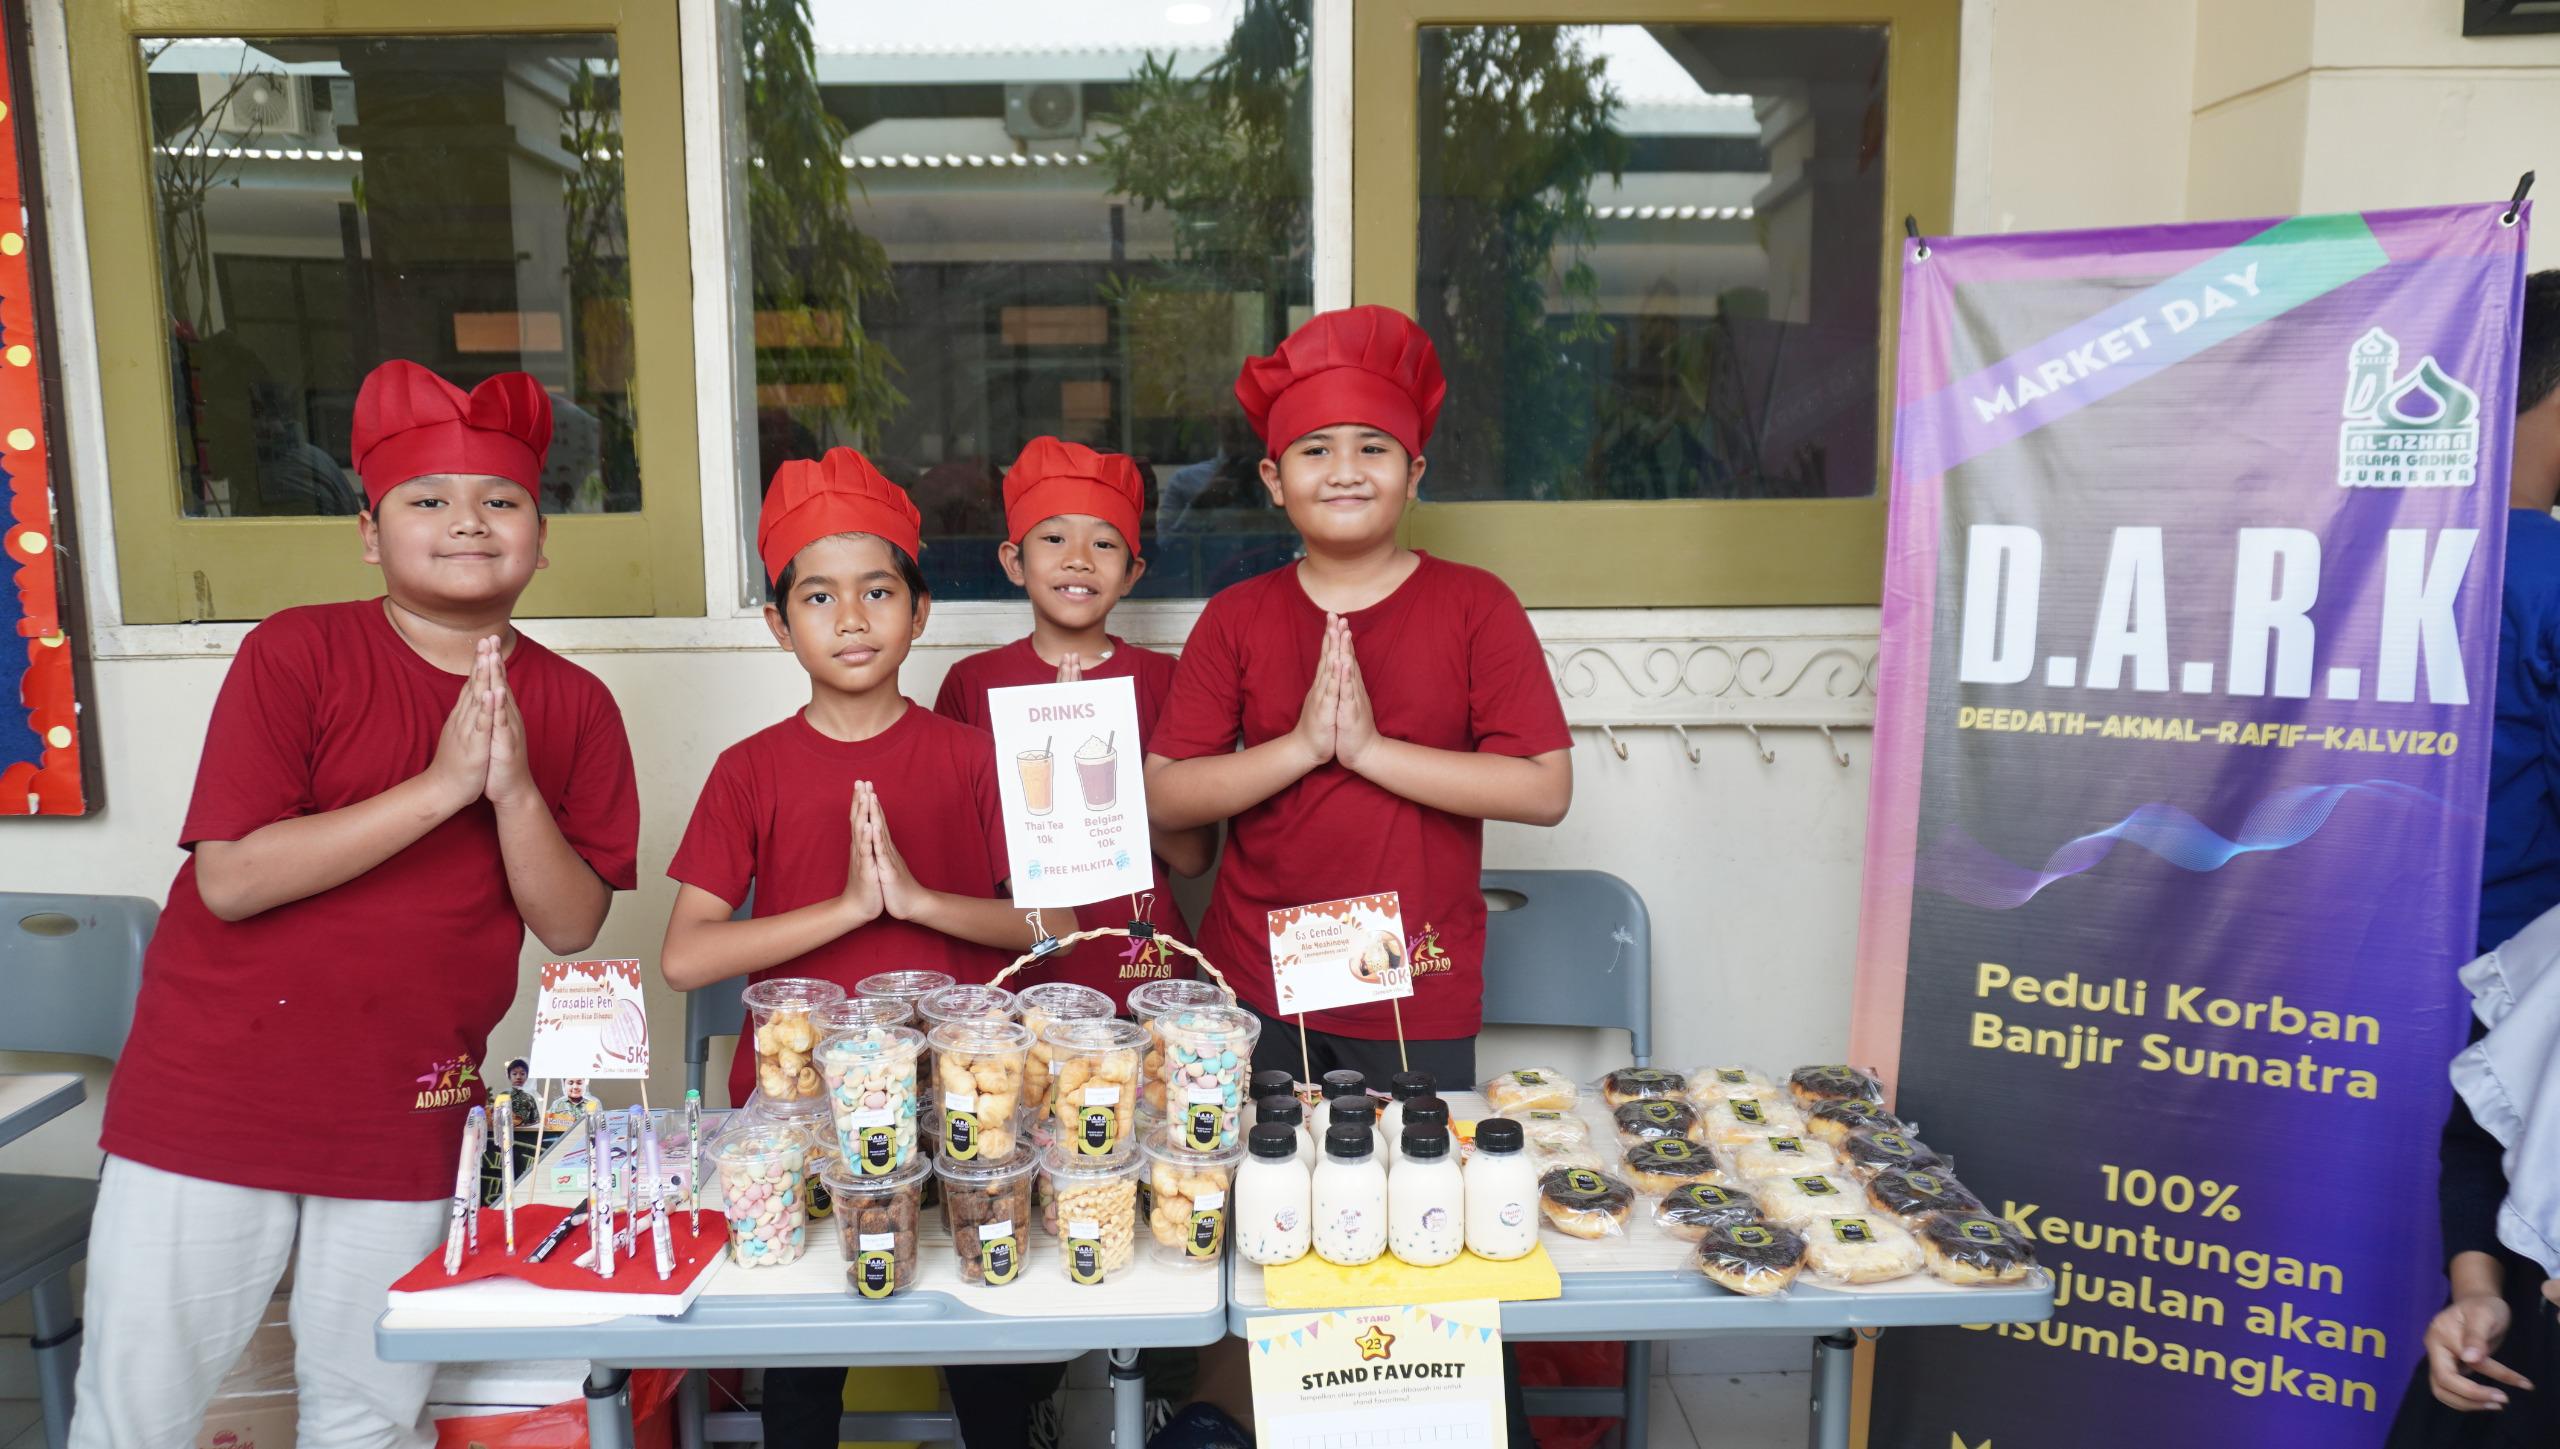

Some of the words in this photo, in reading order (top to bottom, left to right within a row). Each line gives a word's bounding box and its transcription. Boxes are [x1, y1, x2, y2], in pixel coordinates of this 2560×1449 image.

[1973, 316, 2154, 424] MARKET
[2162, 261, 2263, 335] DAY
[2350, 434, 2468, 450] AL-AZHAR
[2345, 454, 2400, 467] KELAPA
[2406, 454, 2471, 467] GADING
[2344, 470, 2469, 482] SURABAYA
[1959, 524, 2480, 706] D.A.R.K
[1028, 703, 1096, 723] DRINKS
[1024, 821, 1046, 831] Thai
[1047, 820, 1064, 830] Tea
[1084, 813, 1124, 828] Belgian
[1089, 824, 1122, 838] Choco
[1037, 835, 1053, 844] 10k
[1097, 839, 1116, 849] 10k
[1044, 864, 1068, 875] FREE
[1071, 859, 1114, 874] MILKITA
[1310, 925, 1342, 939] Cendol
[1119, 964, 1172, 979] ADABTASI
[1378, 968, 1408, 987] 10K
[552, 996, 594, 1010] Erasable
[597, 996, 613, 1009] Pen
[1976, 962, 2147, 1017] Peduli
[2166, 985, 2381, 1045] Korban
[626, 1046, 643, 1063] 5K
[1970, 1012, 2123, 1070] Banjir
[2140, 1034, 2379, 1100] Sumatra
[2100, 1164, 2242, 1223] 100%
[2003, 1200, 2344, 1295] Keuntungan
[2042, 1262, 2226, 1327] jualan
[2245, 1298, 2388, 1359] akan
[1356, 1315, 1391, 1324] STAND
[1366, 1338, 1382, 1350] 23
[1960, 1320, 2378, 1412] sumbangkan
[1301, 1367, 1368, 1390] STAND
[1373, 1363, 1465, 1382] FAVORIT
